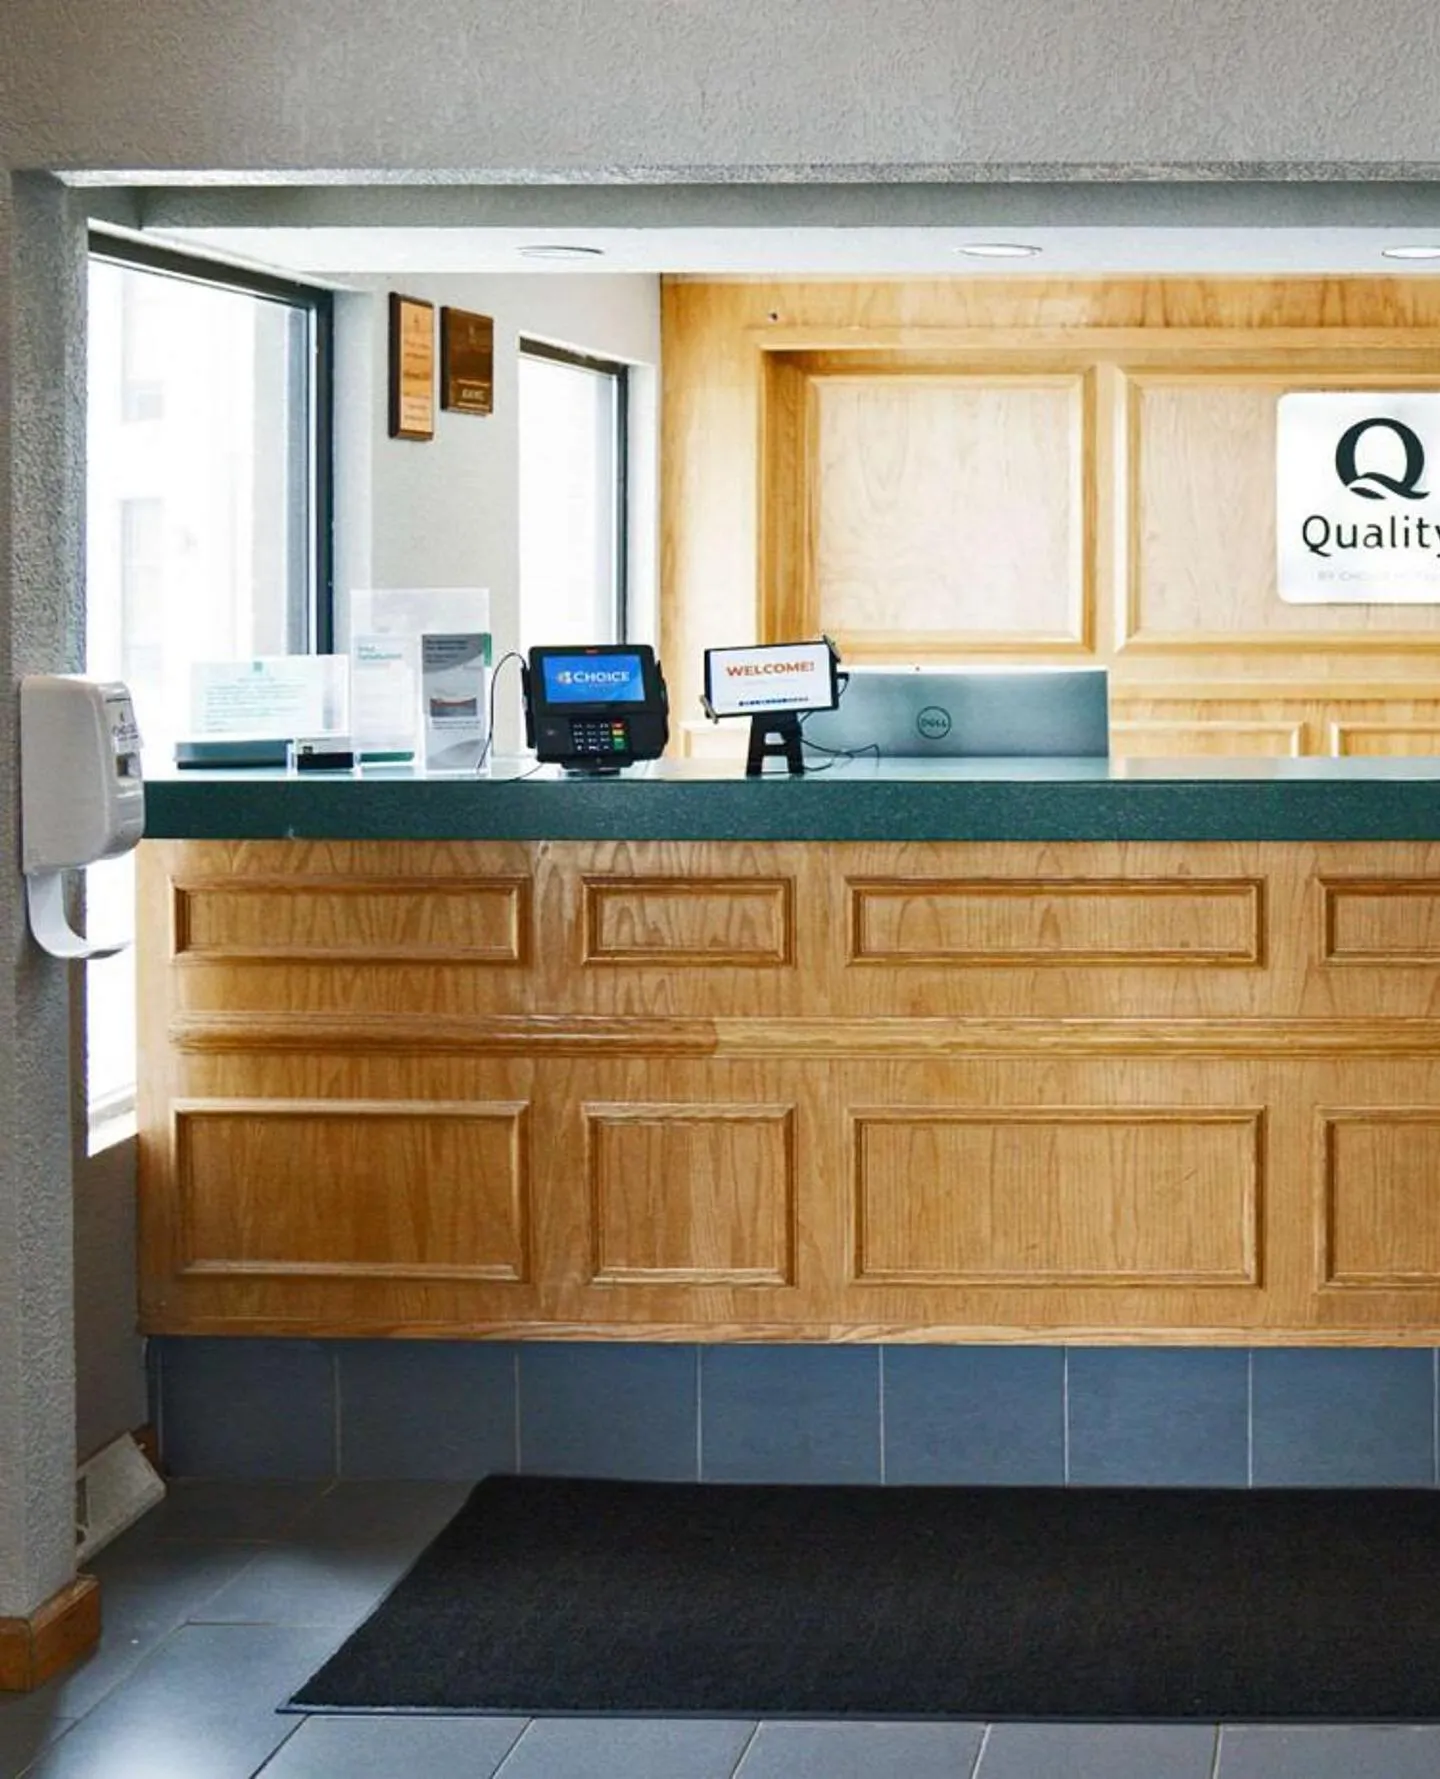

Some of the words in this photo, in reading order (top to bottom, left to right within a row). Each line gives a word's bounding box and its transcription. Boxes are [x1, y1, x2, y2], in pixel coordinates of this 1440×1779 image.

[1335, 418, 1430, 500] Q
[726, 661, 815, 676] WELCOME!
[573, 671, 630, 684] CHOICE
[920, 717, 947, 728] DELL
